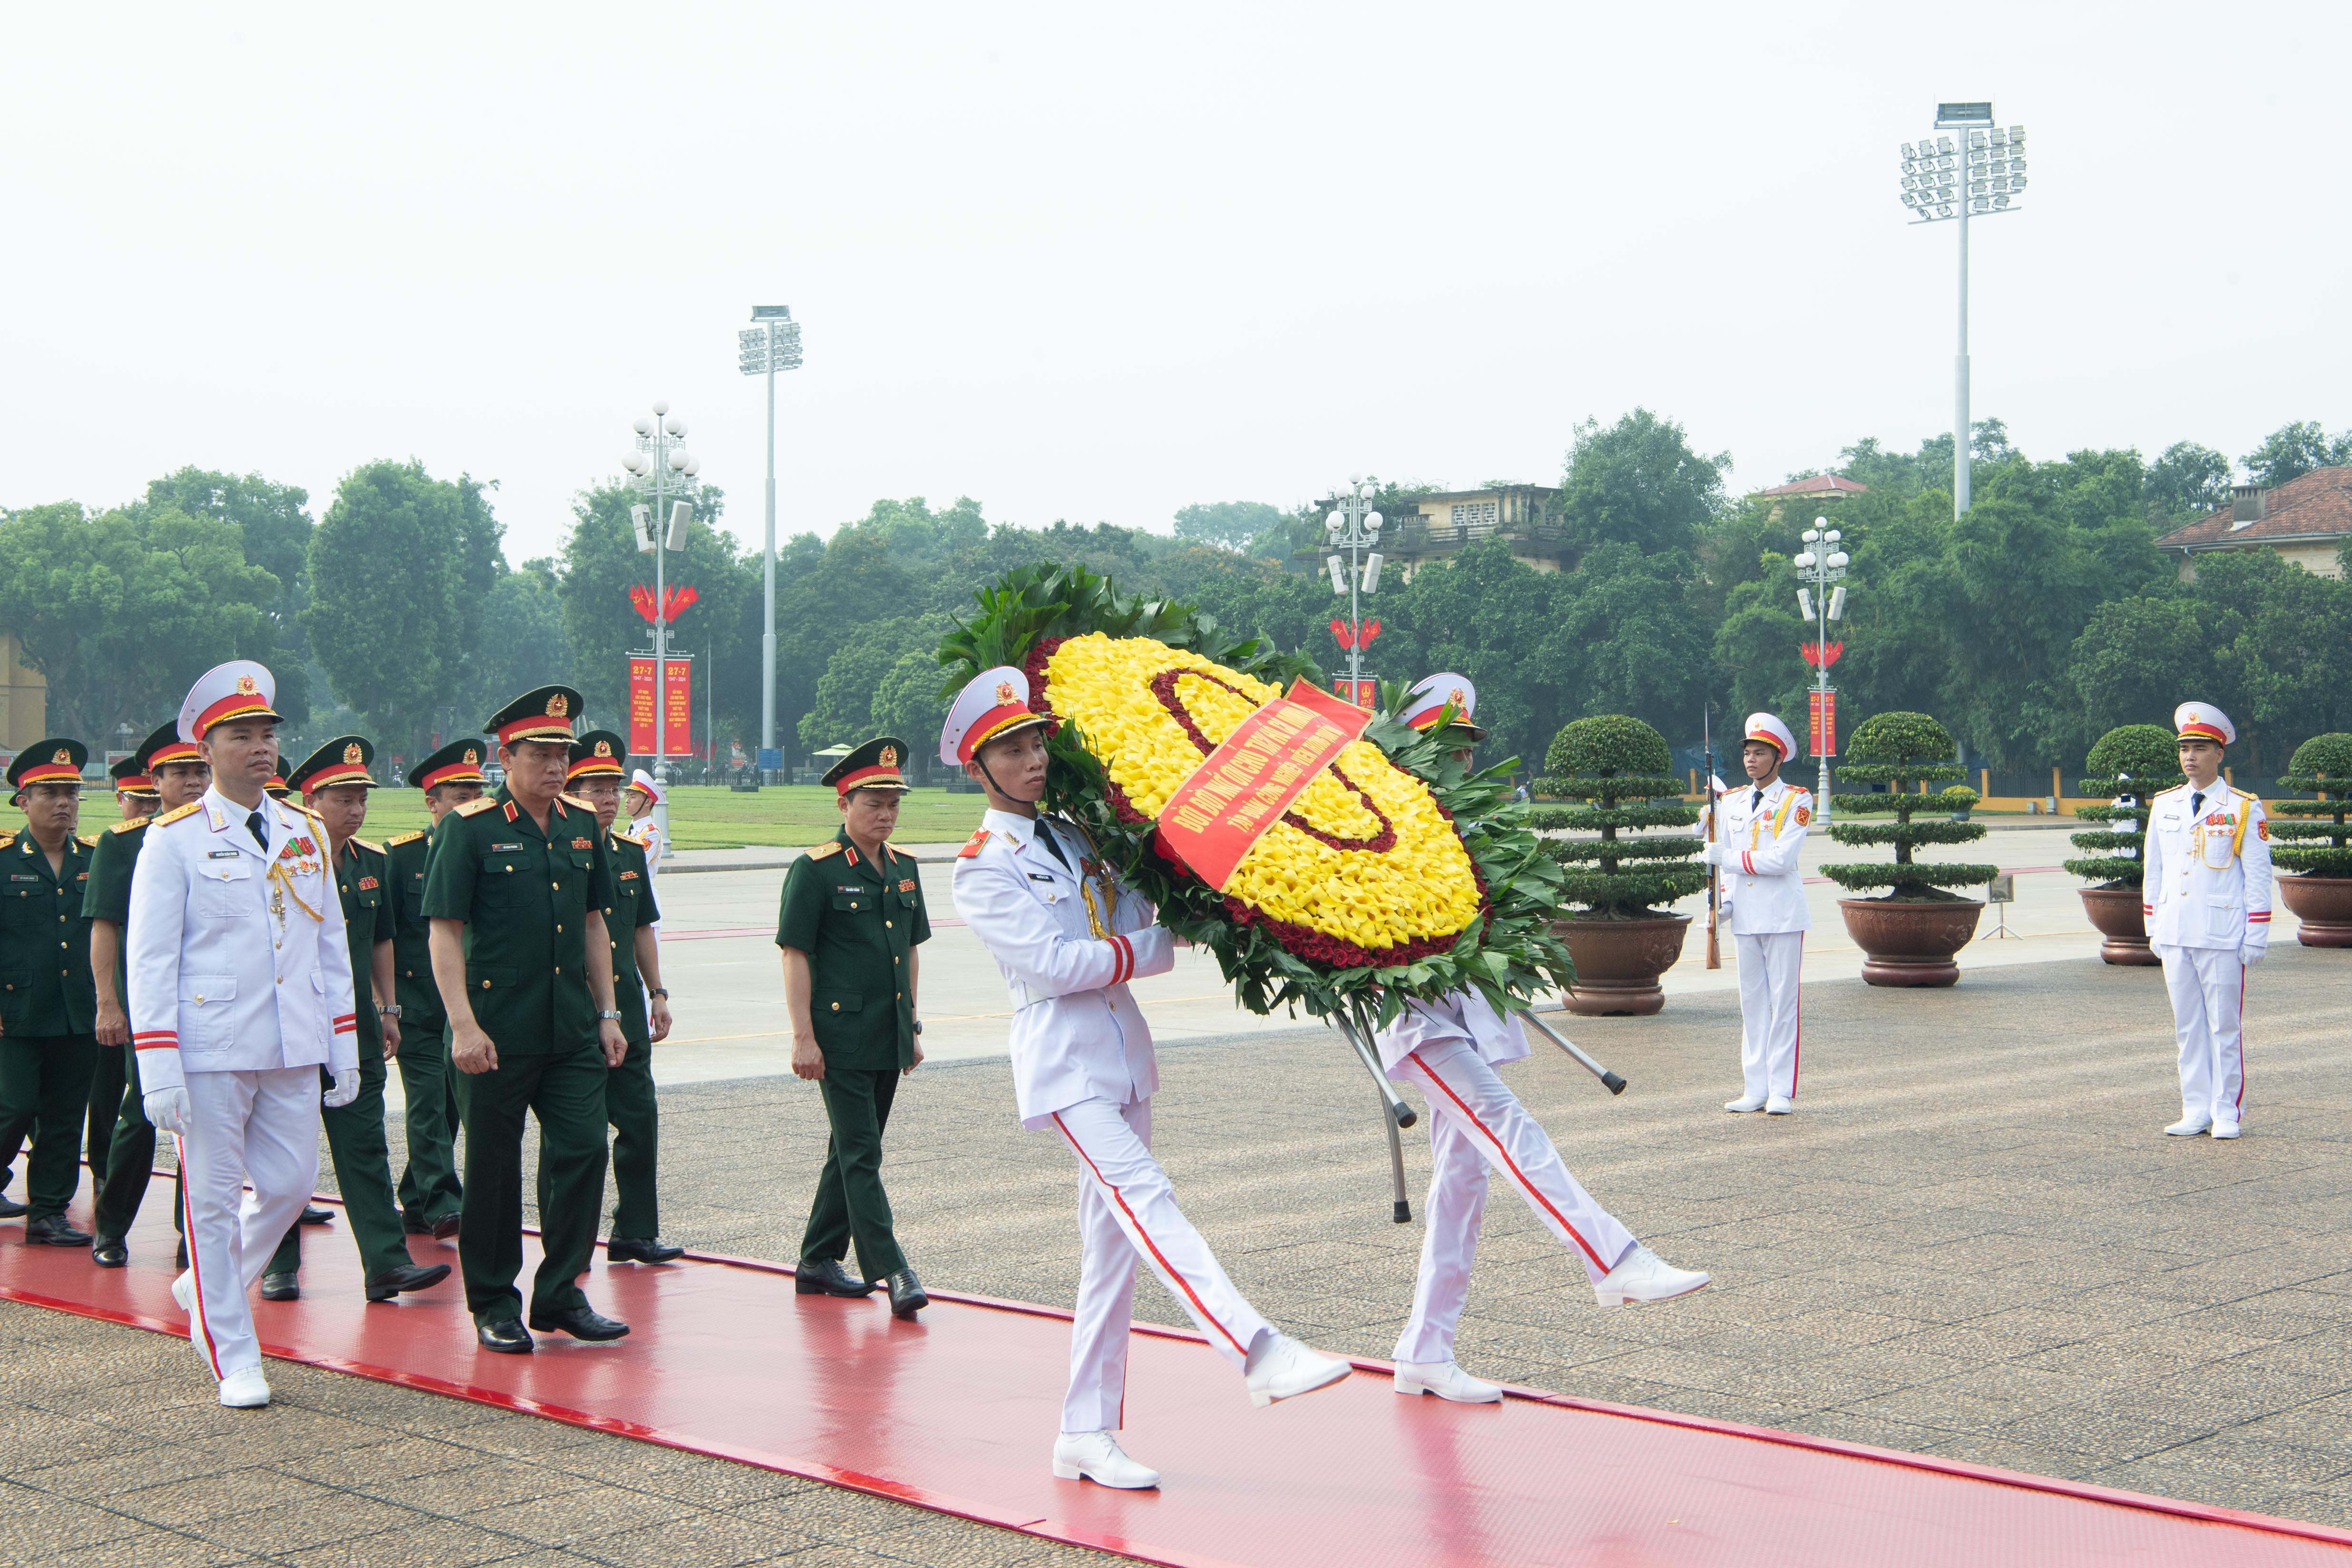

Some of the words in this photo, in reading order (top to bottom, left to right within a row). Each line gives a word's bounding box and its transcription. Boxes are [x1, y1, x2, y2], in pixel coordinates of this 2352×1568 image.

[633, 666, 652, 675] 27-7
[668, 667, 686, 675] 27-7
[1254, 719, 1292, 745] HỒ
[1244, 731, 1282, 758] TỊCH
[1287, 746, 1318, 766] VIỄN
[1226, 744, 1269, 774] CHỦ
[1203, 770, 1244, 801] NHỚ
[1219, 763, 1254, 786] ƠN
[1270, 761, 1306, 786] NGHIỆP
[1186, 788, 1228, 817] ĐỜI
[1254, 782, 1287, 805] CÔNG
[1170, 804, 1213, 834] ĐỜI
[1242, 796, 1271, 819] ĐOÀN
[1226, 814, 1255, 833] TẬP
